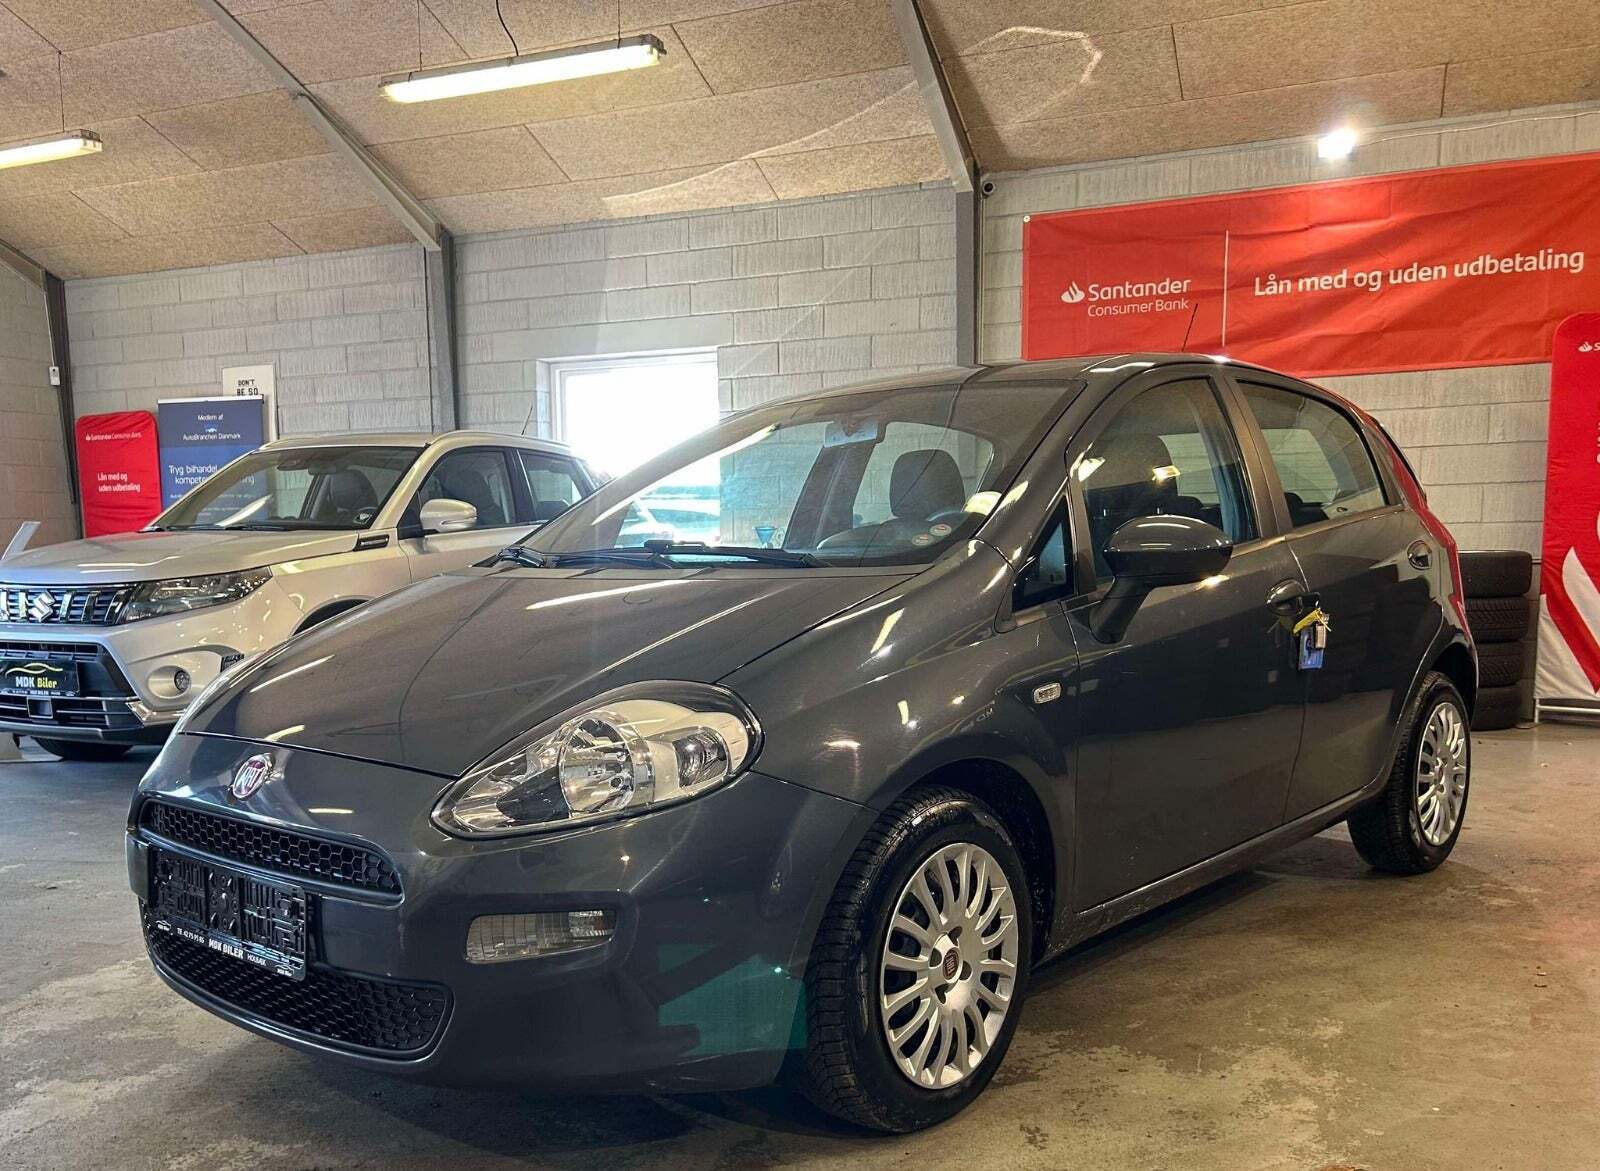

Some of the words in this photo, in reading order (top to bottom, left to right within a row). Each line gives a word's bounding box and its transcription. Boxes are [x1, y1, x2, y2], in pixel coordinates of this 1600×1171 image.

[1254, 274, 1292, 297] Lån
[1297, 269, 1347, 292] med
[1353, 269, 1382, 292] og
[1389, 262, 1447, 285] uden
[1453, 248, 1585, 277] udbetaling
[1088, 278, 1191, 302] Santander
[1088, 302, 1153, 318] Consumer
[1155, 298, 1189, 312] Bank
[237, 379, 255, 387] DON'T
[236, 388, 245, 396] BE
[248, 387, 259, 396] SO
[197, 413, 217, 421] Medlem
[217, 412, 224, 421] af
[182, 432, 218, 441] AutoBranchen
[218, 431, 241, 440] Danmark
[169, 464, 184, 475] Tryg
[185, 463, 218, 475] bilhandel
[97, 471, 108, 481] Lån
[107, 472, 120, 481] med
[120, 473, 128, 482] og
[98, 484, 112, 492] uden
[112, 482, 141, 493] udbetaling
[15, 676, 35, 688] MDK
[37, 677, 58, 688] Biler
[208, 938, 222, 952] MDK
[222, 943, 244, 960] BILER
